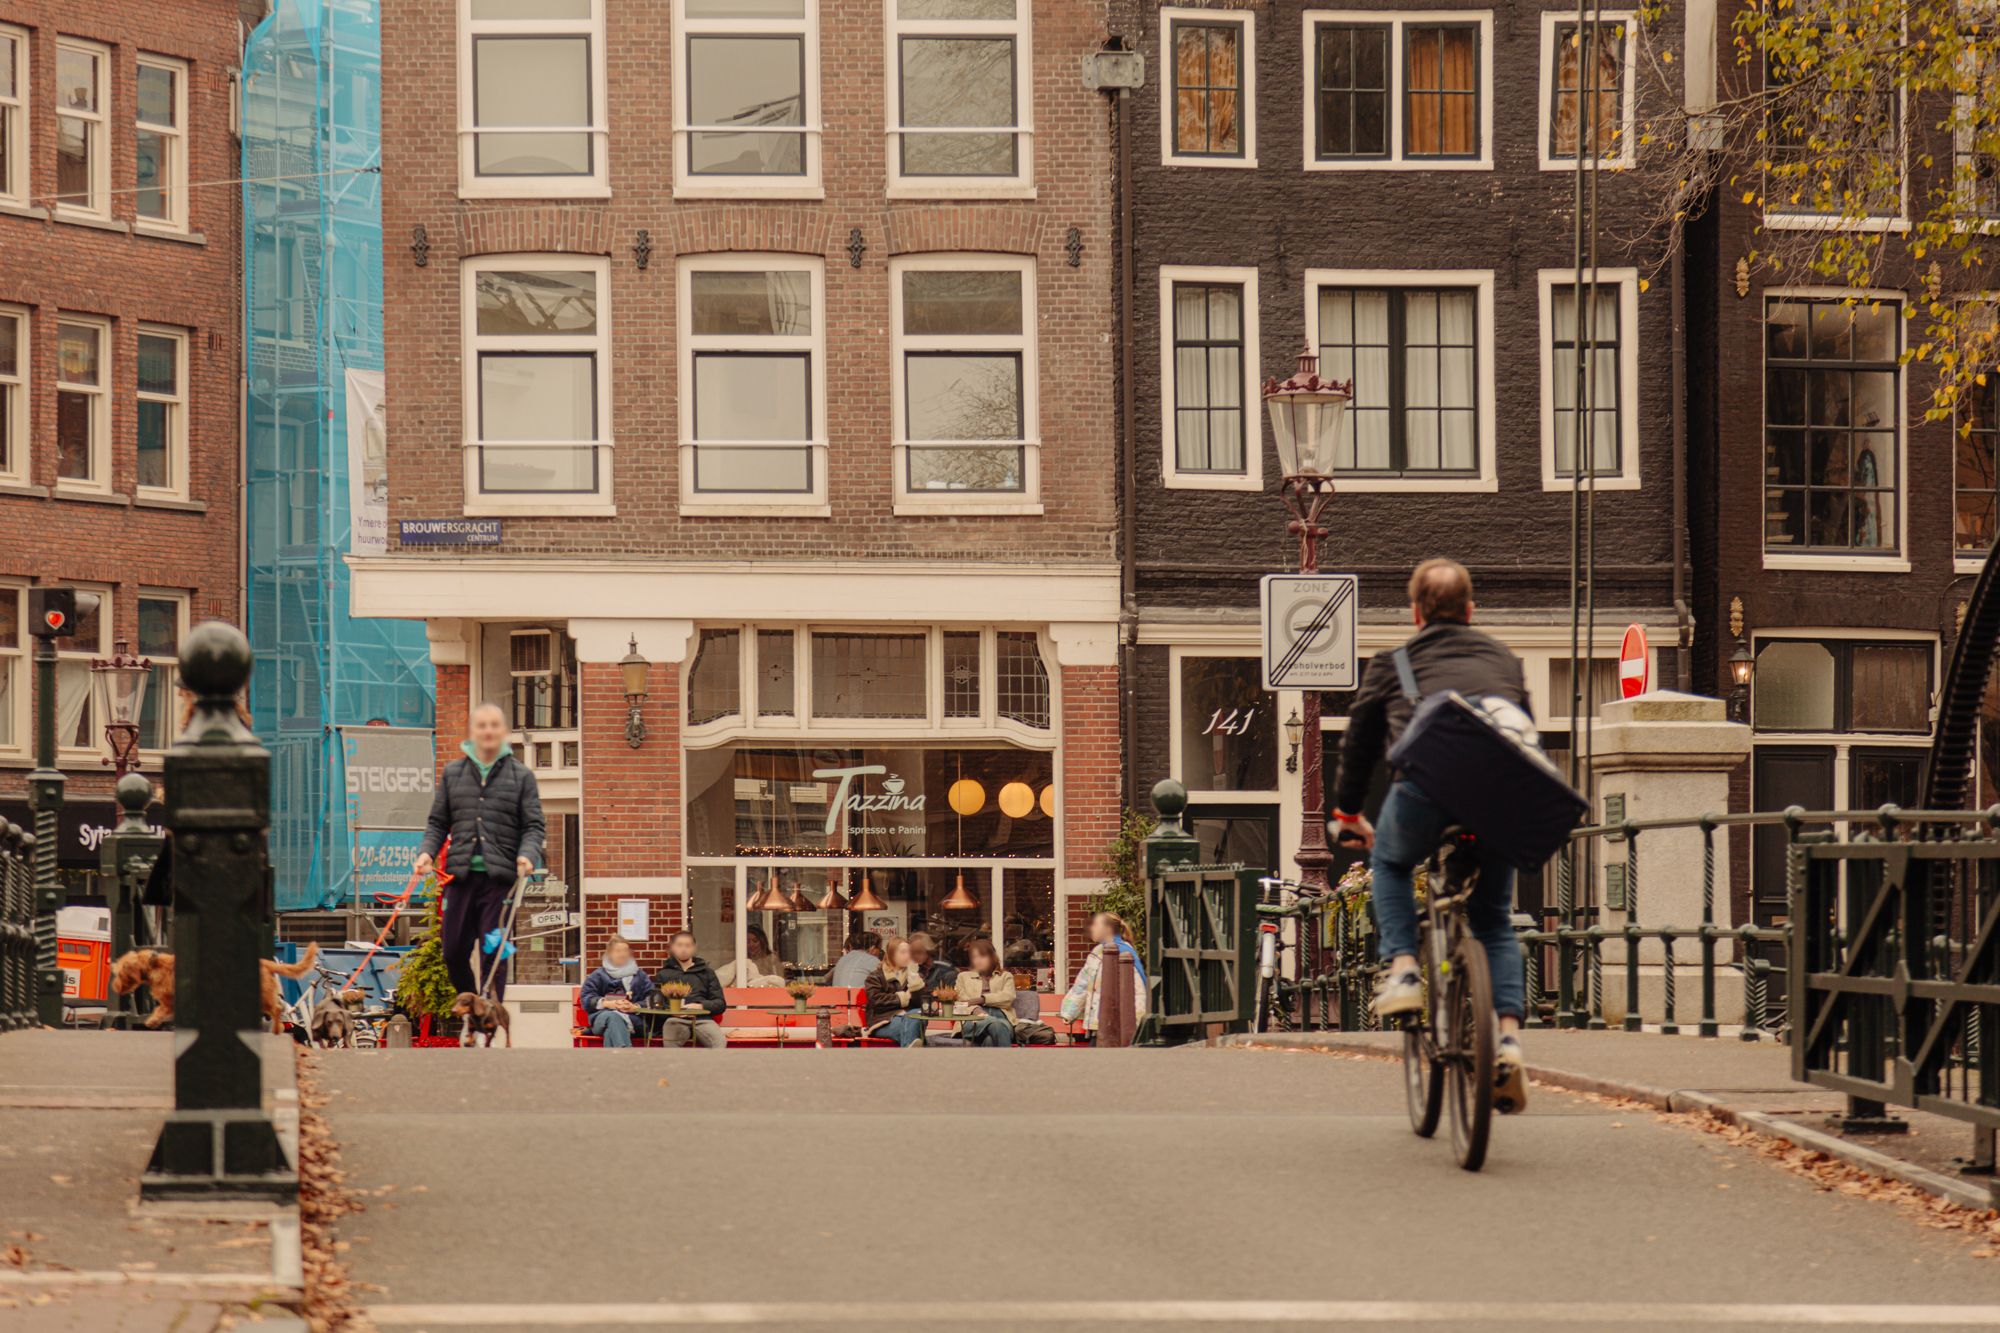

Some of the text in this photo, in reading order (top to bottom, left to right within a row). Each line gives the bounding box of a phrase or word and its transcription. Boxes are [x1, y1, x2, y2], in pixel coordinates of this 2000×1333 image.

[402, 521, 498, 534] BROUWERSGRACHT
[466, 534, 498, 542] CENTRUM
[1293, 582, 1330, 593] ZONE
[1279, 661, 1345, 670] oholverbod
[1201, 708, 1254, 735] 141
[347, 766, 433, 793] STEIGERS
[812, 765, 926, 835] Tazzina
[847, 825, 927, 836] Espresso e Panini
[537, 914, 561, 923] OPEN
